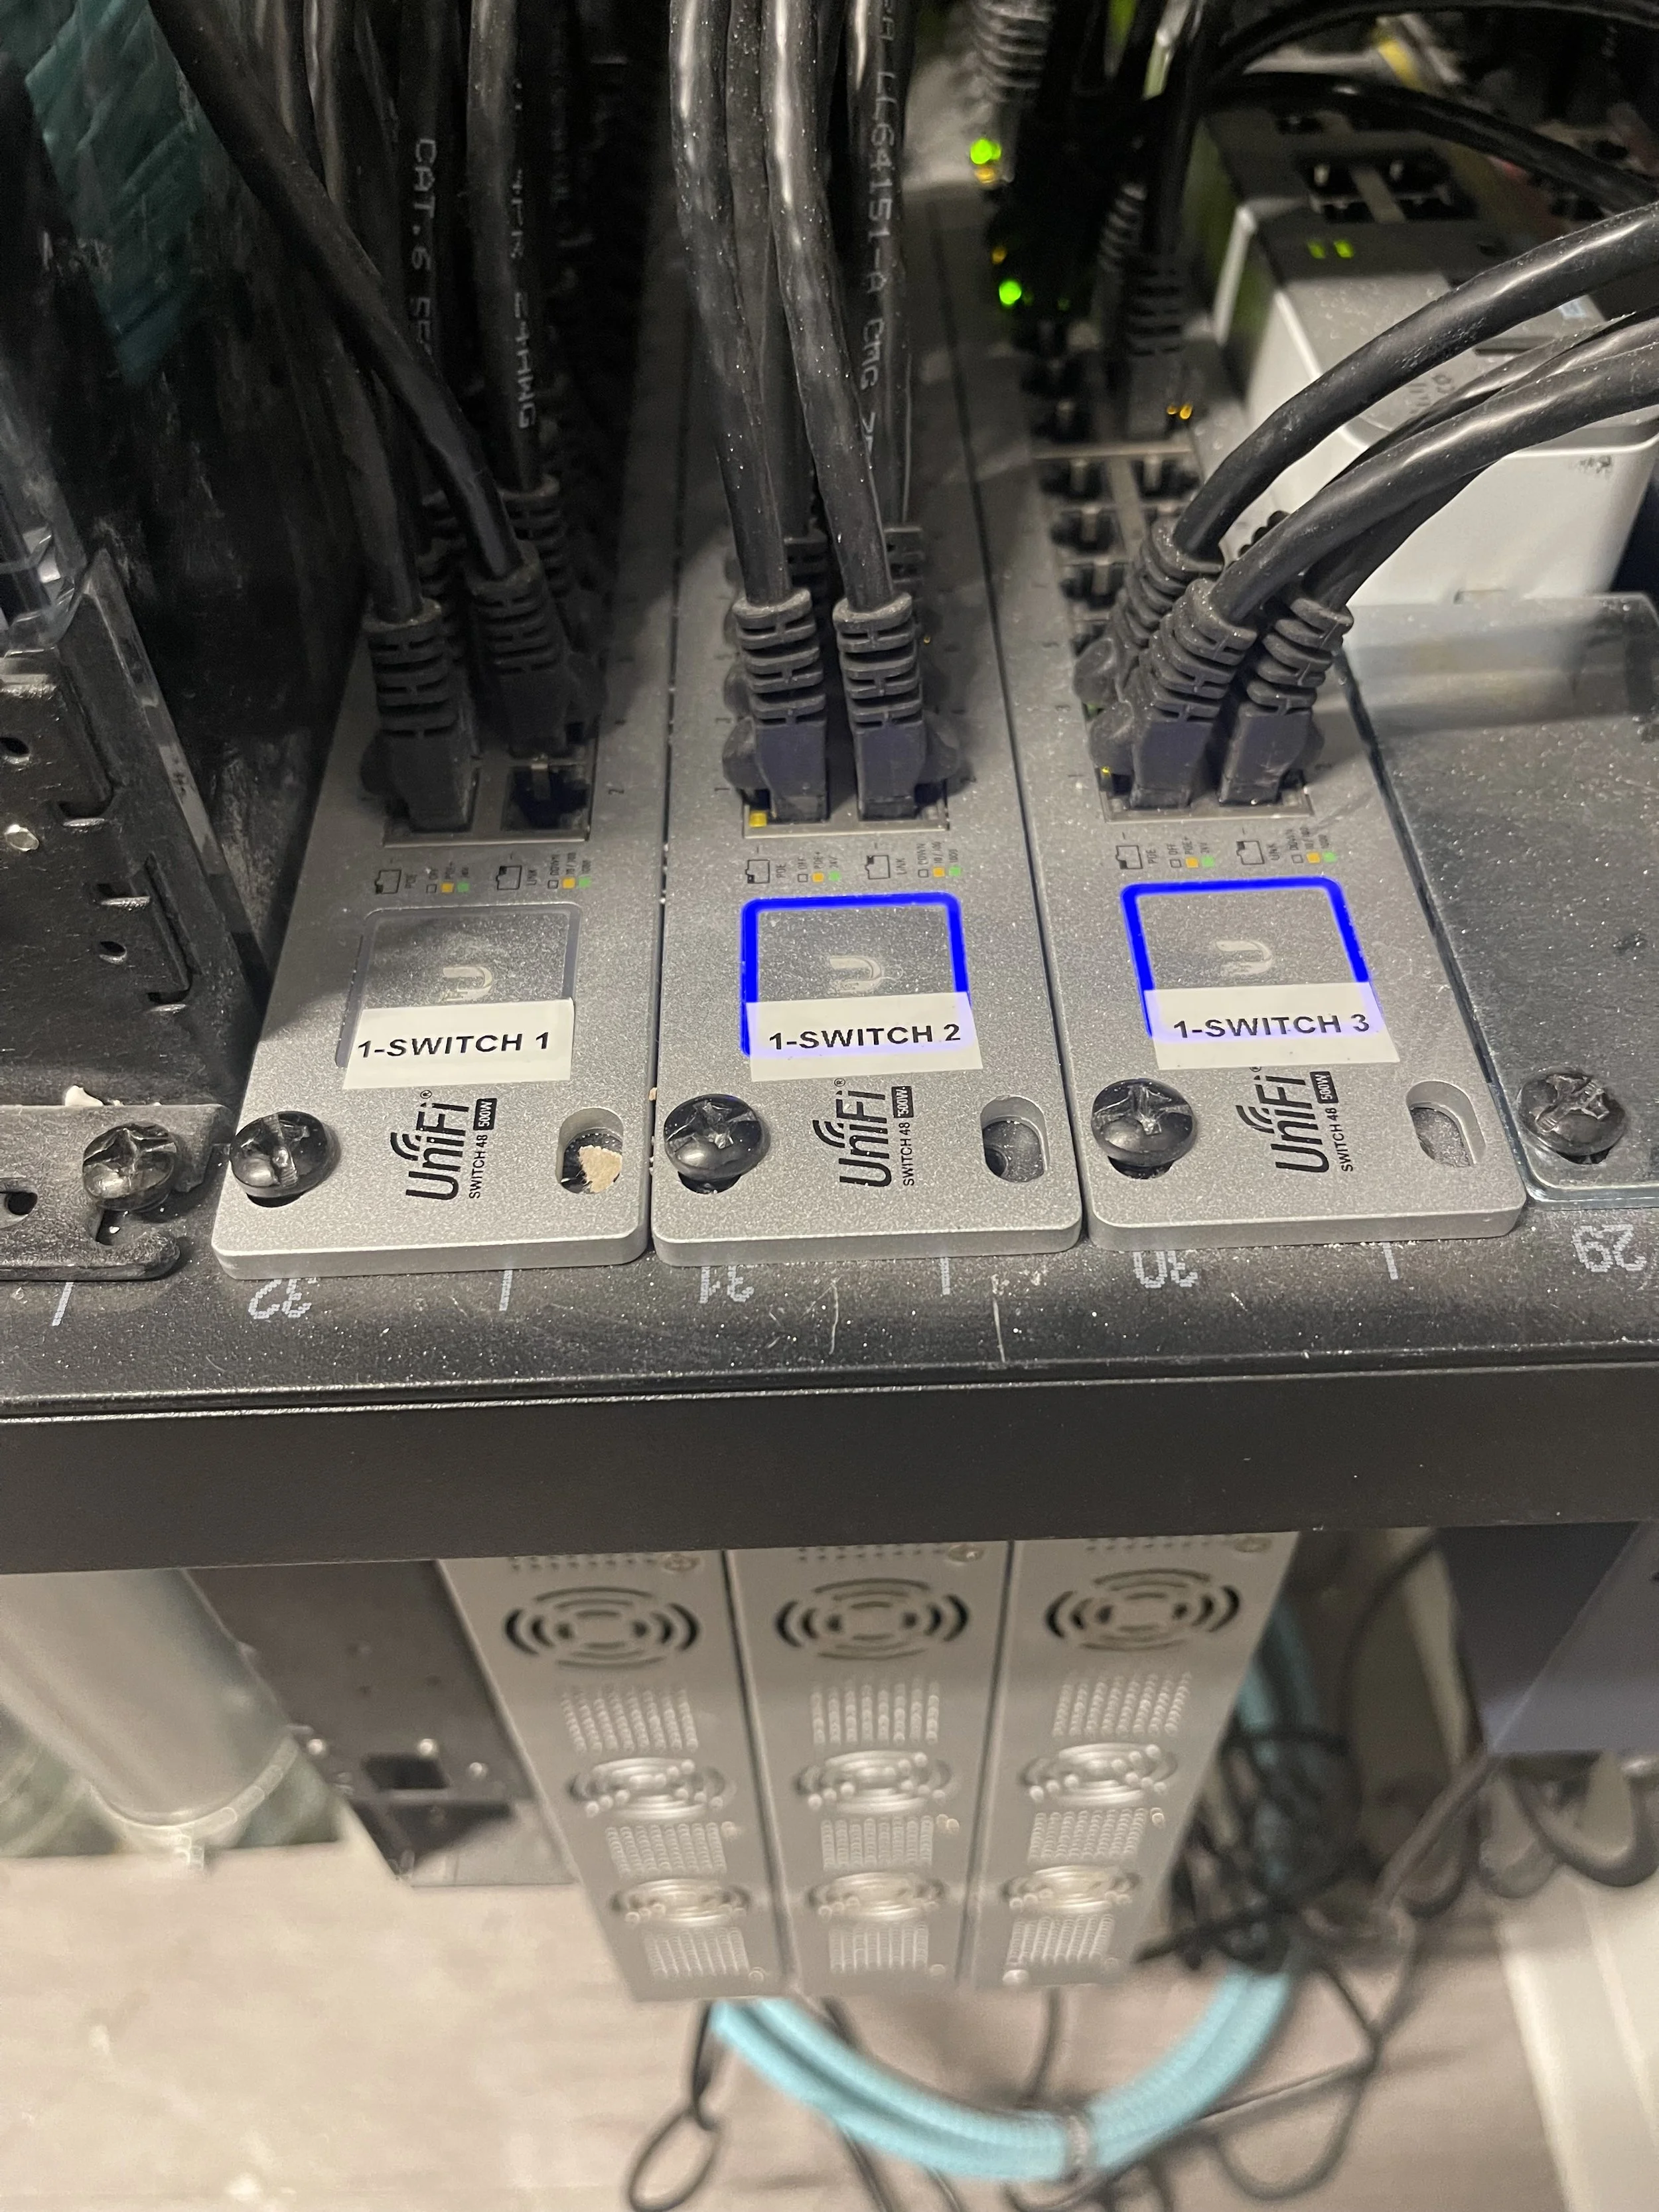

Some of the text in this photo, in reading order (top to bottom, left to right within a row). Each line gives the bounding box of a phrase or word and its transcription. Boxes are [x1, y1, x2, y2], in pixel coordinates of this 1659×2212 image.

[357, 1031, 549, 1059] 1-SWITCH 1
[769, 1023, 961, 1050] 1-SWITCH 2
[1173, 1013, 1370, 1039] 1-SWITCH 3
[1315, 1074, 1334, 1100] 500W
[405, 1102, 470, 1201] UniFi
[469, 1101, 493, 1199] SWITCH 48 500W
[836, 1090, 893, 1187] UniFi
[895, 1088, 915, 1187] SWITCH 48 500W
[1254, 1075, 1330, 1173] UniFi
[1329, 1124, 1354, 1172] SWITCH
